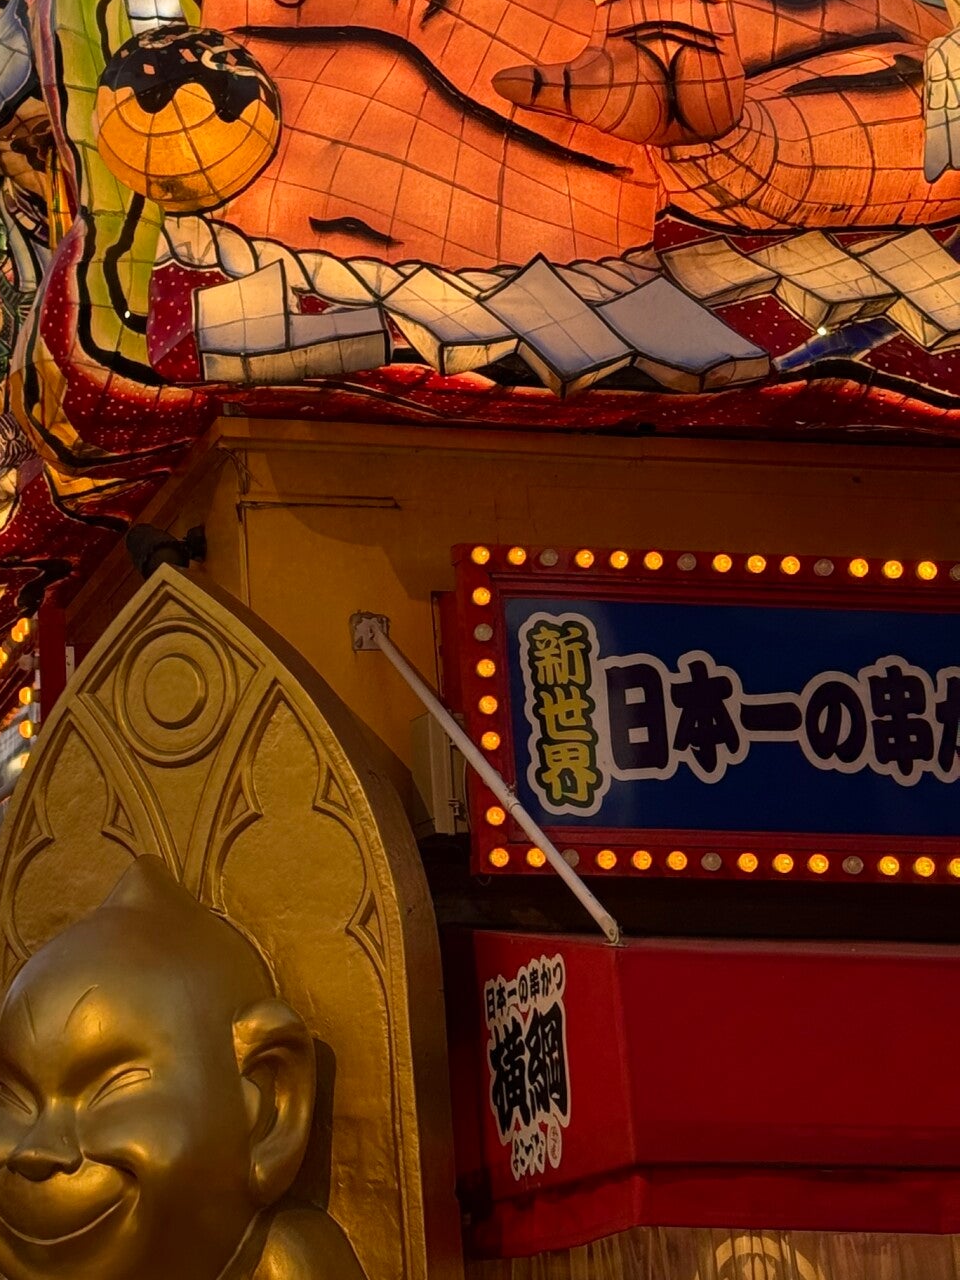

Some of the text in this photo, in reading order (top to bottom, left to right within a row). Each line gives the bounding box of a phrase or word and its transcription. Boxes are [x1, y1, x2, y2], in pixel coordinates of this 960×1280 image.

[530, 620, 601, 806] 新世界
[486, 960, 564, 1021] 日本一の串かつ
[491, 1002, 568, 1136] 横綱
